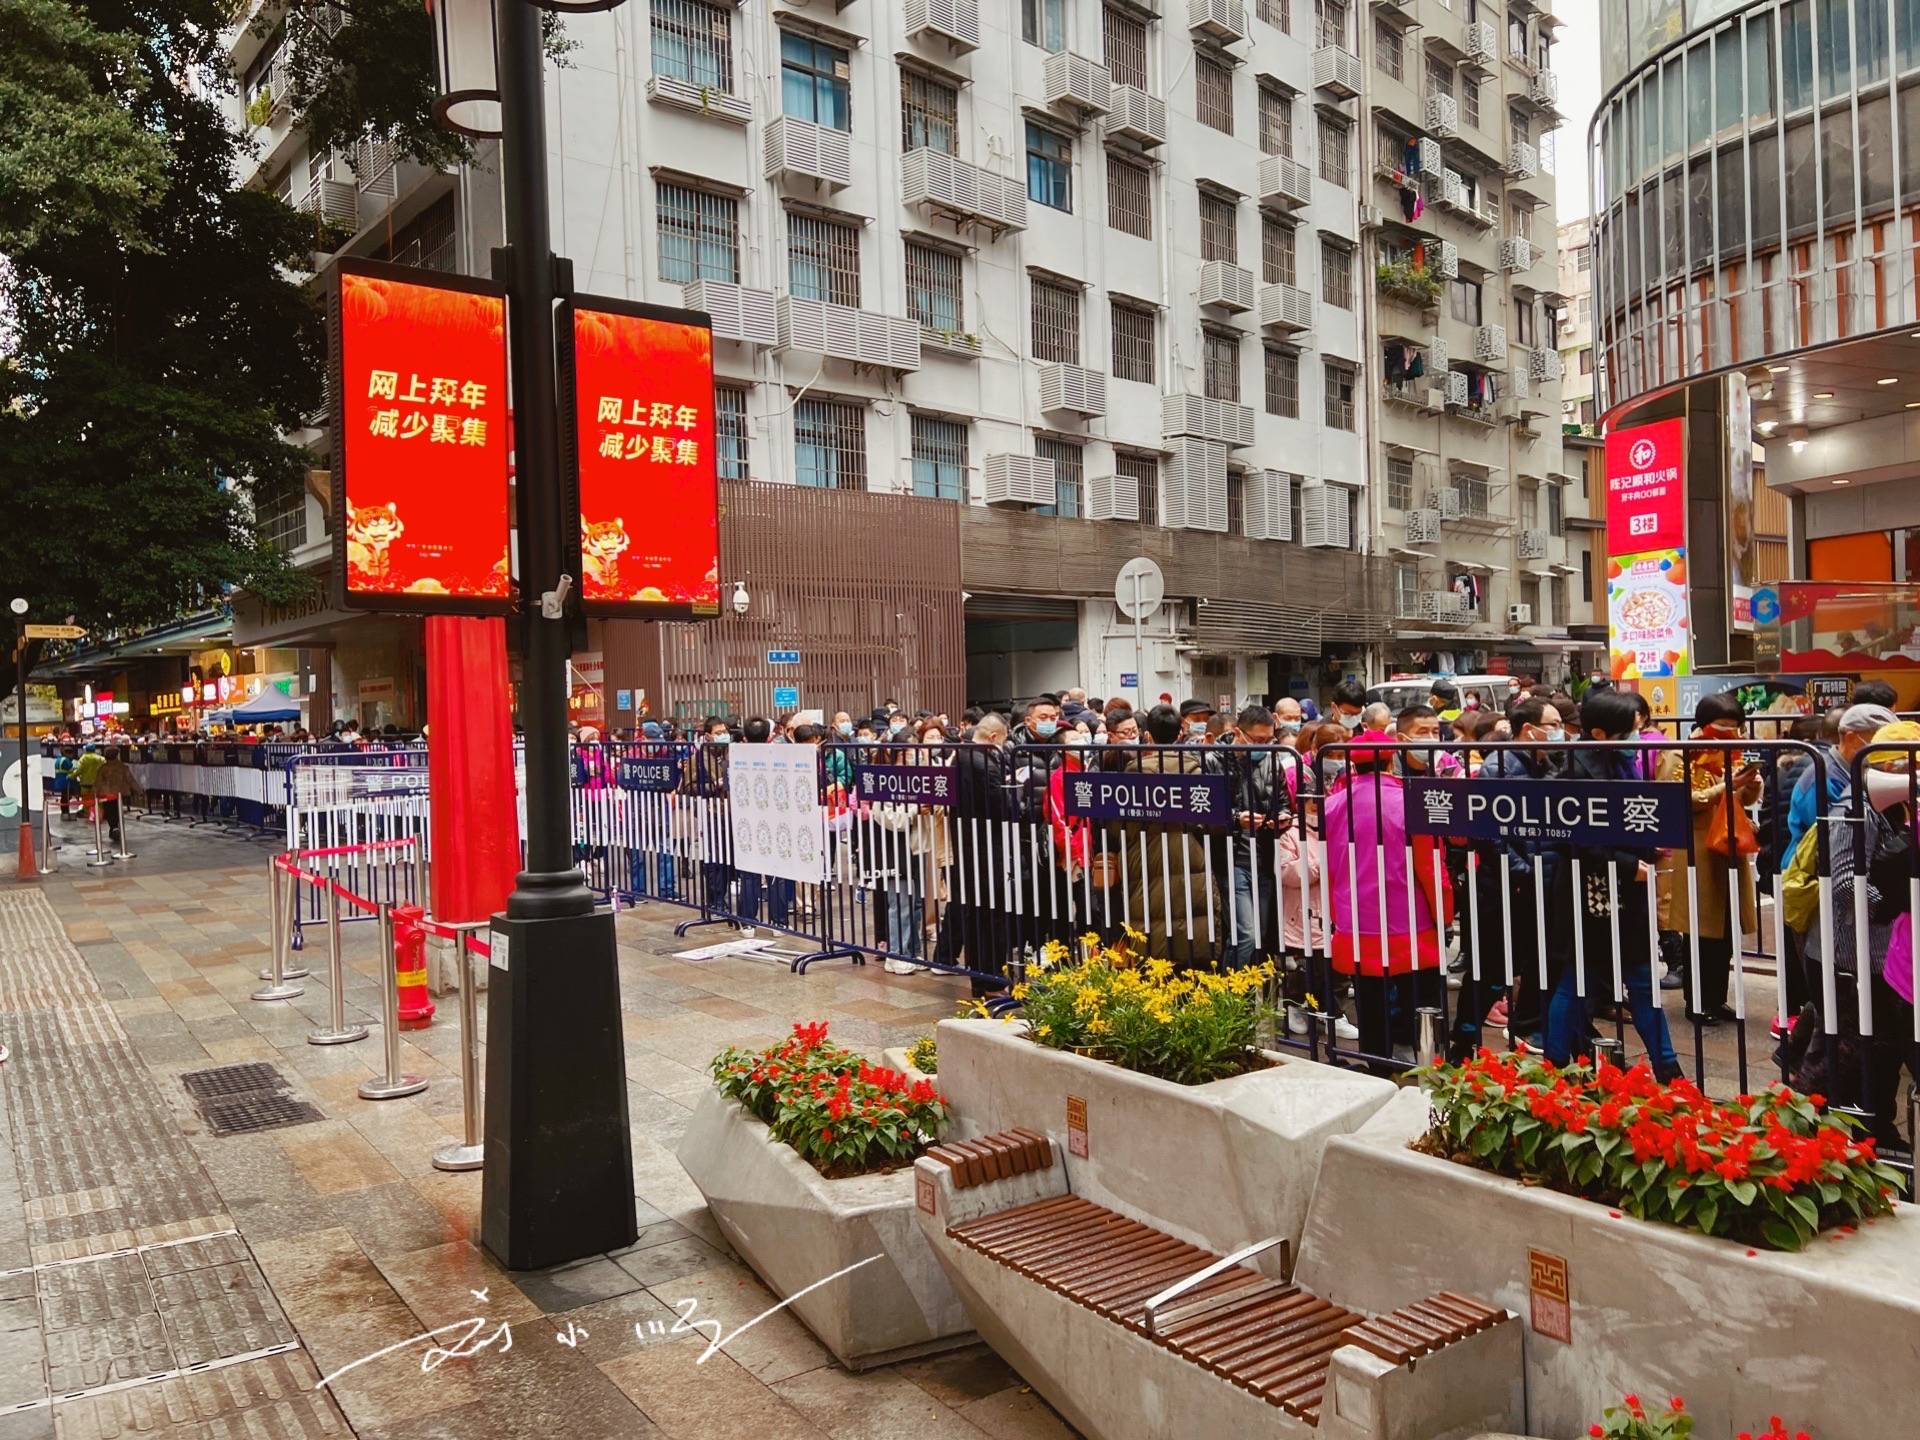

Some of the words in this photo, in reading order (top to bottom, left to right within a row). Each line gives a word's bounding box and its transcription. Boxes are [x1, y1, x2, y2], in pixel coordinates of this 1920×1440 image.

[367, 369, 488, 411] 网上拜年
[368, 408, 488, 447] 减少聚集
[597, 396, 699, 432] 网上拜年
[598, 432, 699, 466] 减少聚集
[1632, 516, 1655, 533] 3楼
[1639, 651, 1657, 664] 2楼
[623, 763, 631, 779] 警
[632, 765, 661, 779] POLICE
[662, 765, 670, 781] 察
[862, 772, 875, 794] 警
[879, 775, 931, 794] POLICE
[934, 774, 948, 798] 察
[1074, 781, 1093, 808] 警
[1100, 784, 1184, 809] POLICE
[1189, 784, 1212, 813] 察
[1423, 789, 1454, 826] 警
[1467, 794, 1610, 828] POLICE
[1623, 794, 1661, 834] 察
